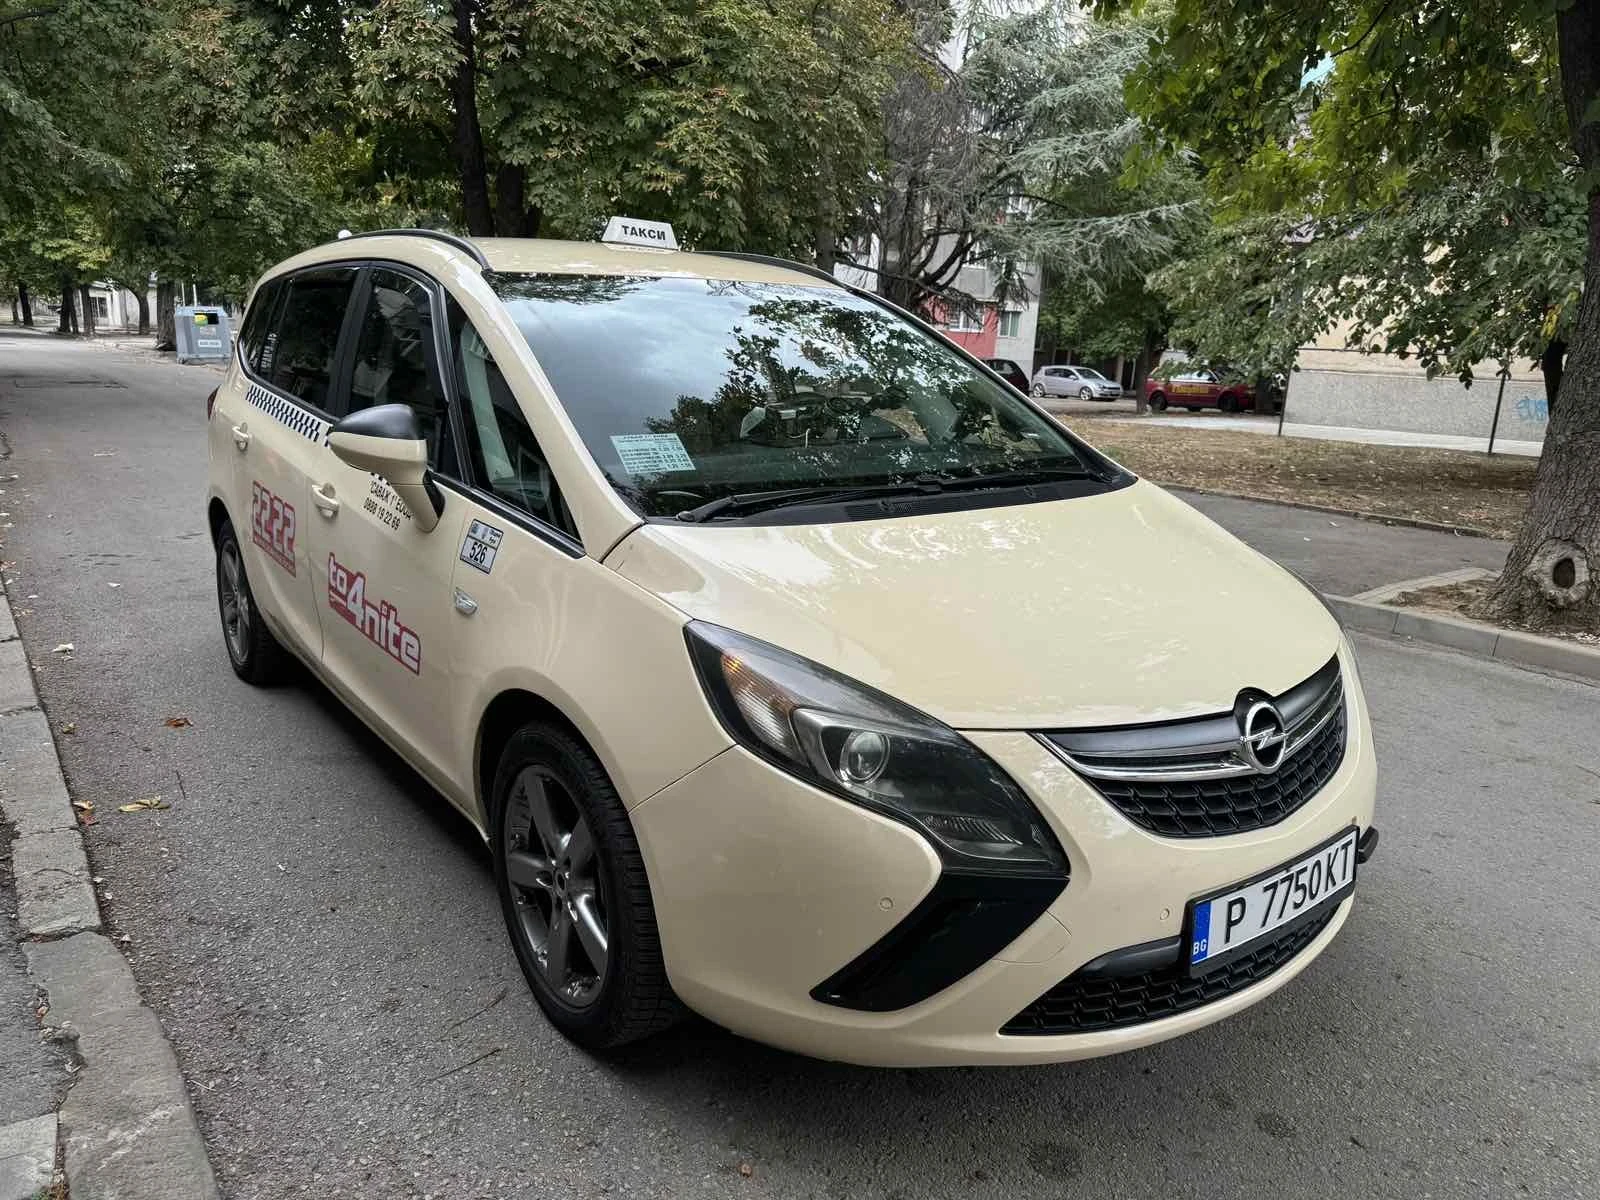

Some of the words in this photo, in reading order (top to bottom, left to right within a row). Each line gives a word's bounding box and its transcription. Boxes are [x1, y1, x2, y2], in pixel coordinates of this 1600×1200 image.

[621, 225, 666, 241] ТАКСИ
[384, 511, 393, 525] 22
[469, 541, 488, 564] 526
[1193, 939, 1208, 956] BG
